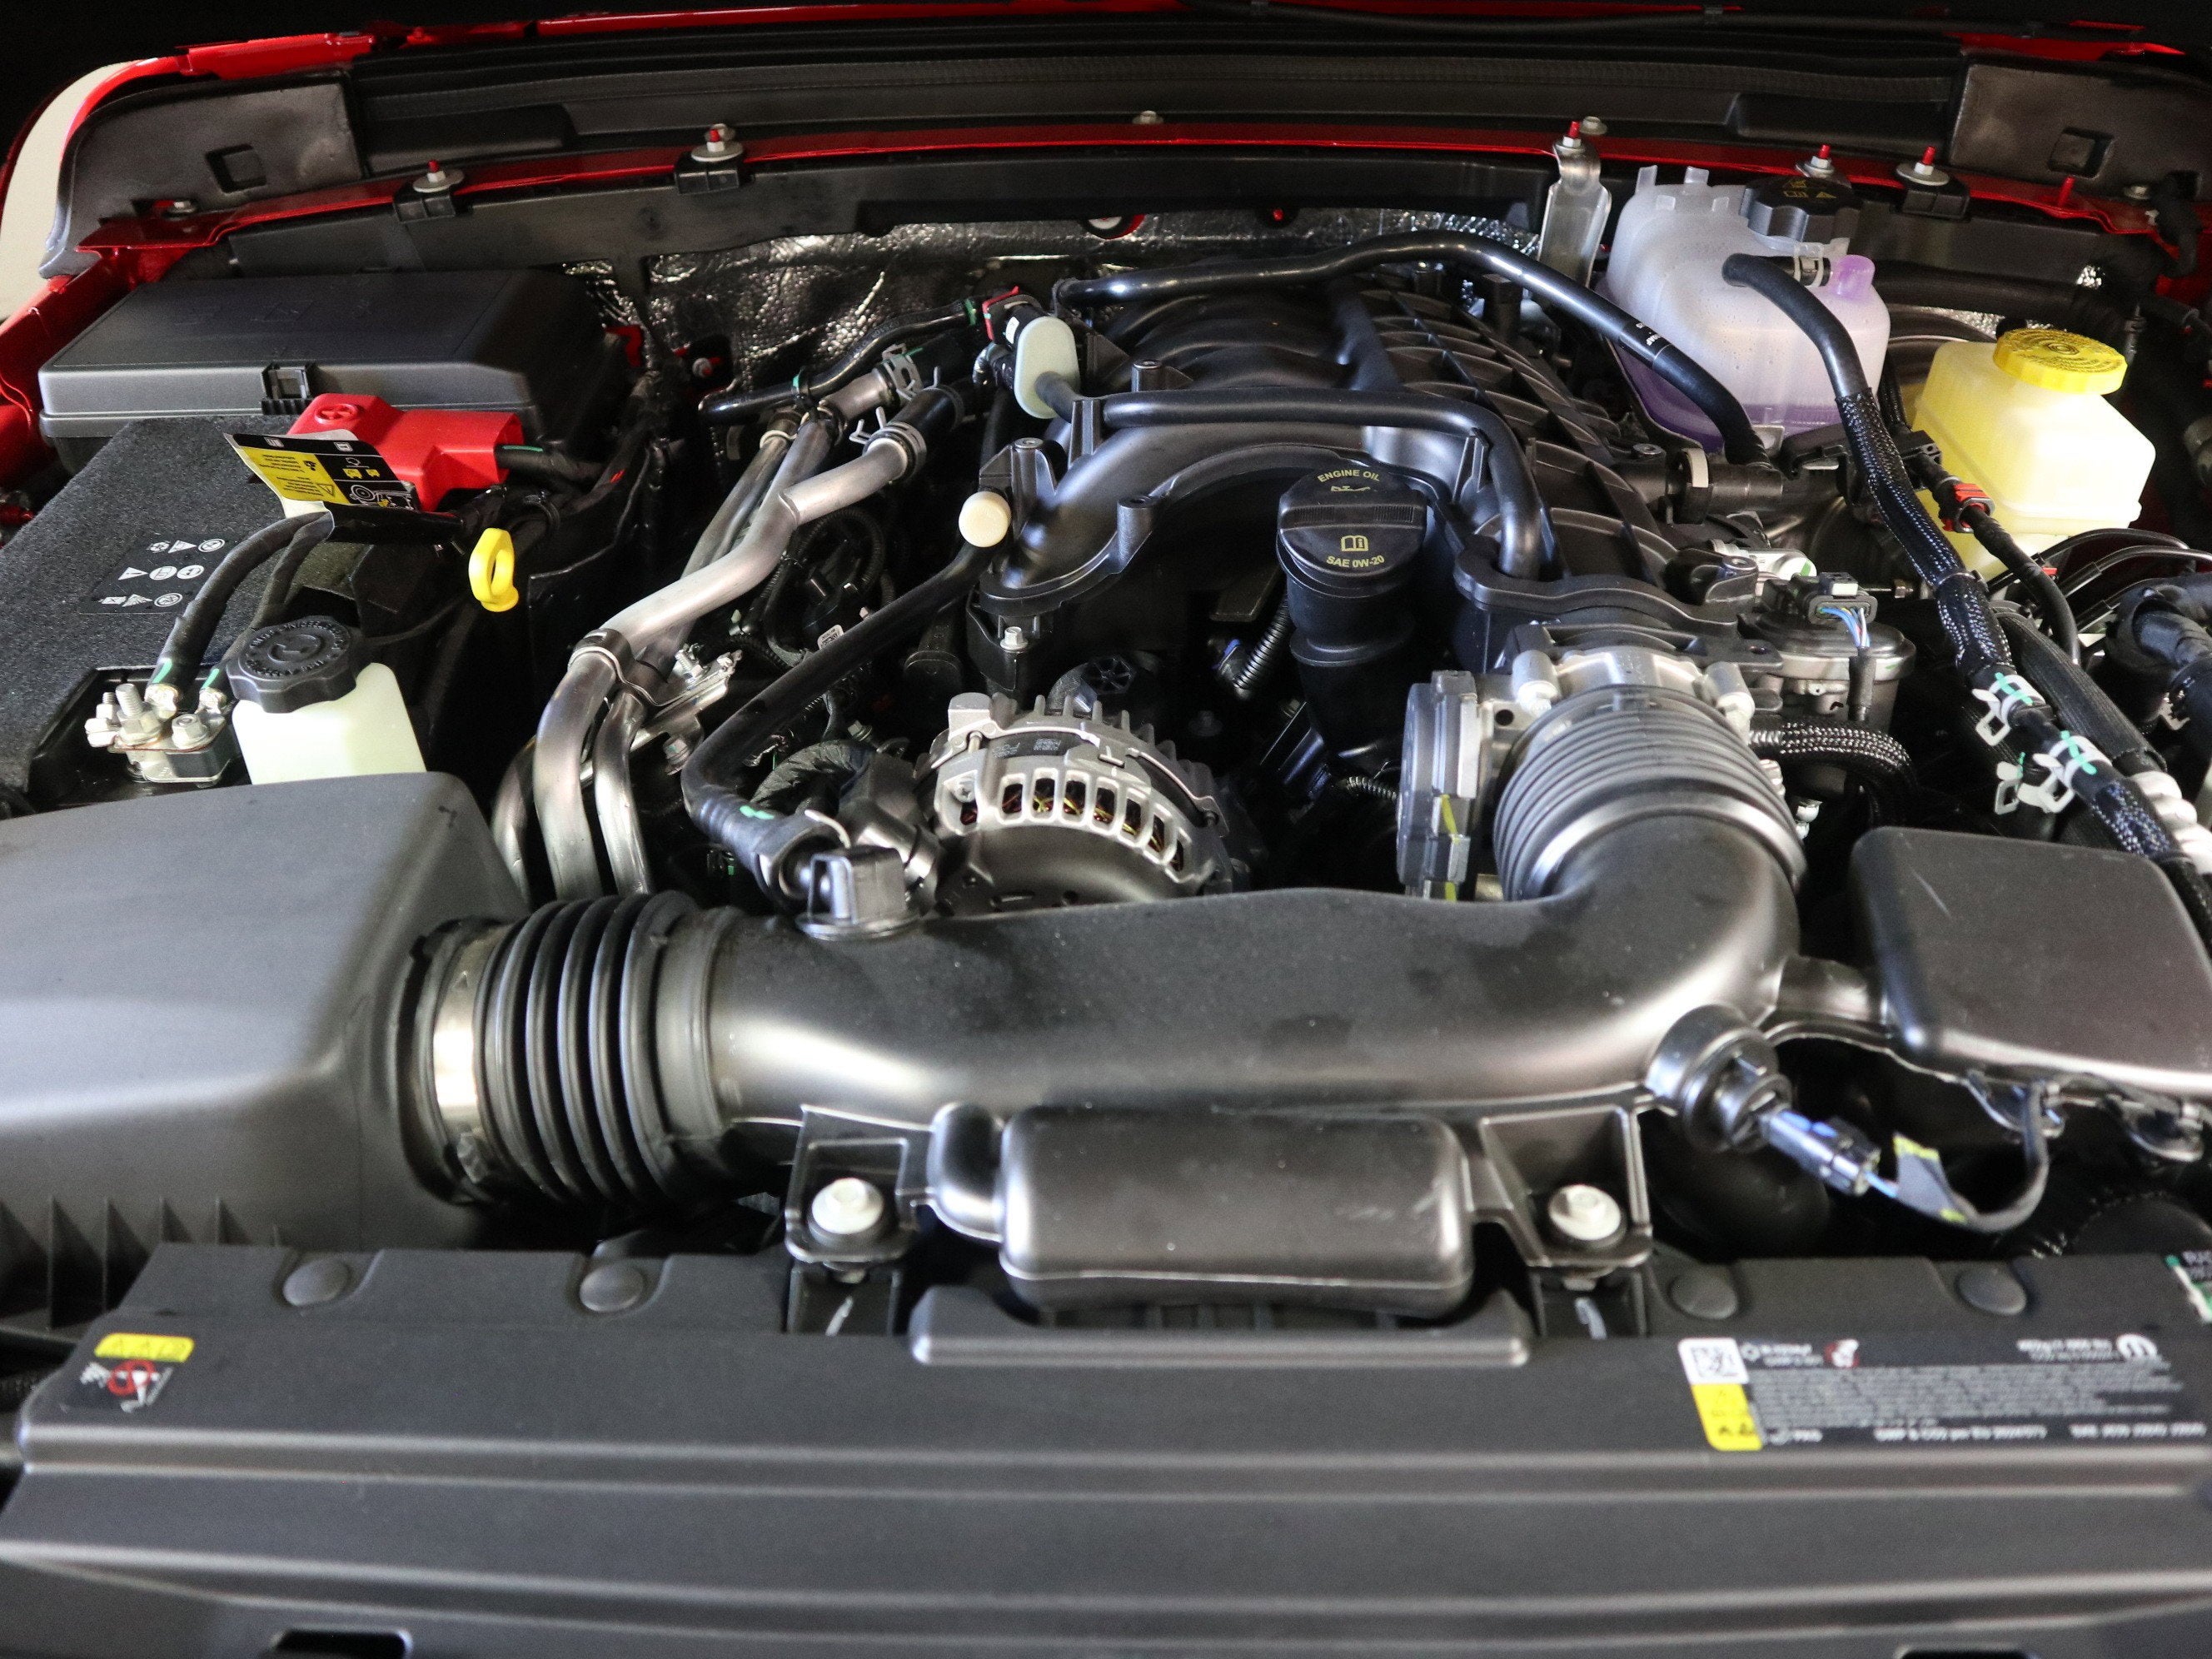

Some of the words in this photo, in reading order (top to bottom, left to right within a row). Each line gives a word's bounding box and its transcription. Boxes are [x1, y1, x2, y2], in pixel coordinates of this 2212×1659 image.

[1317, 469, 1360, 482] ENGINE
[1363, 471, 1380, 482] OIL
[1326, 555, 1350, 568] SAE
[1352, 555, 1385, 568] 0W-20
